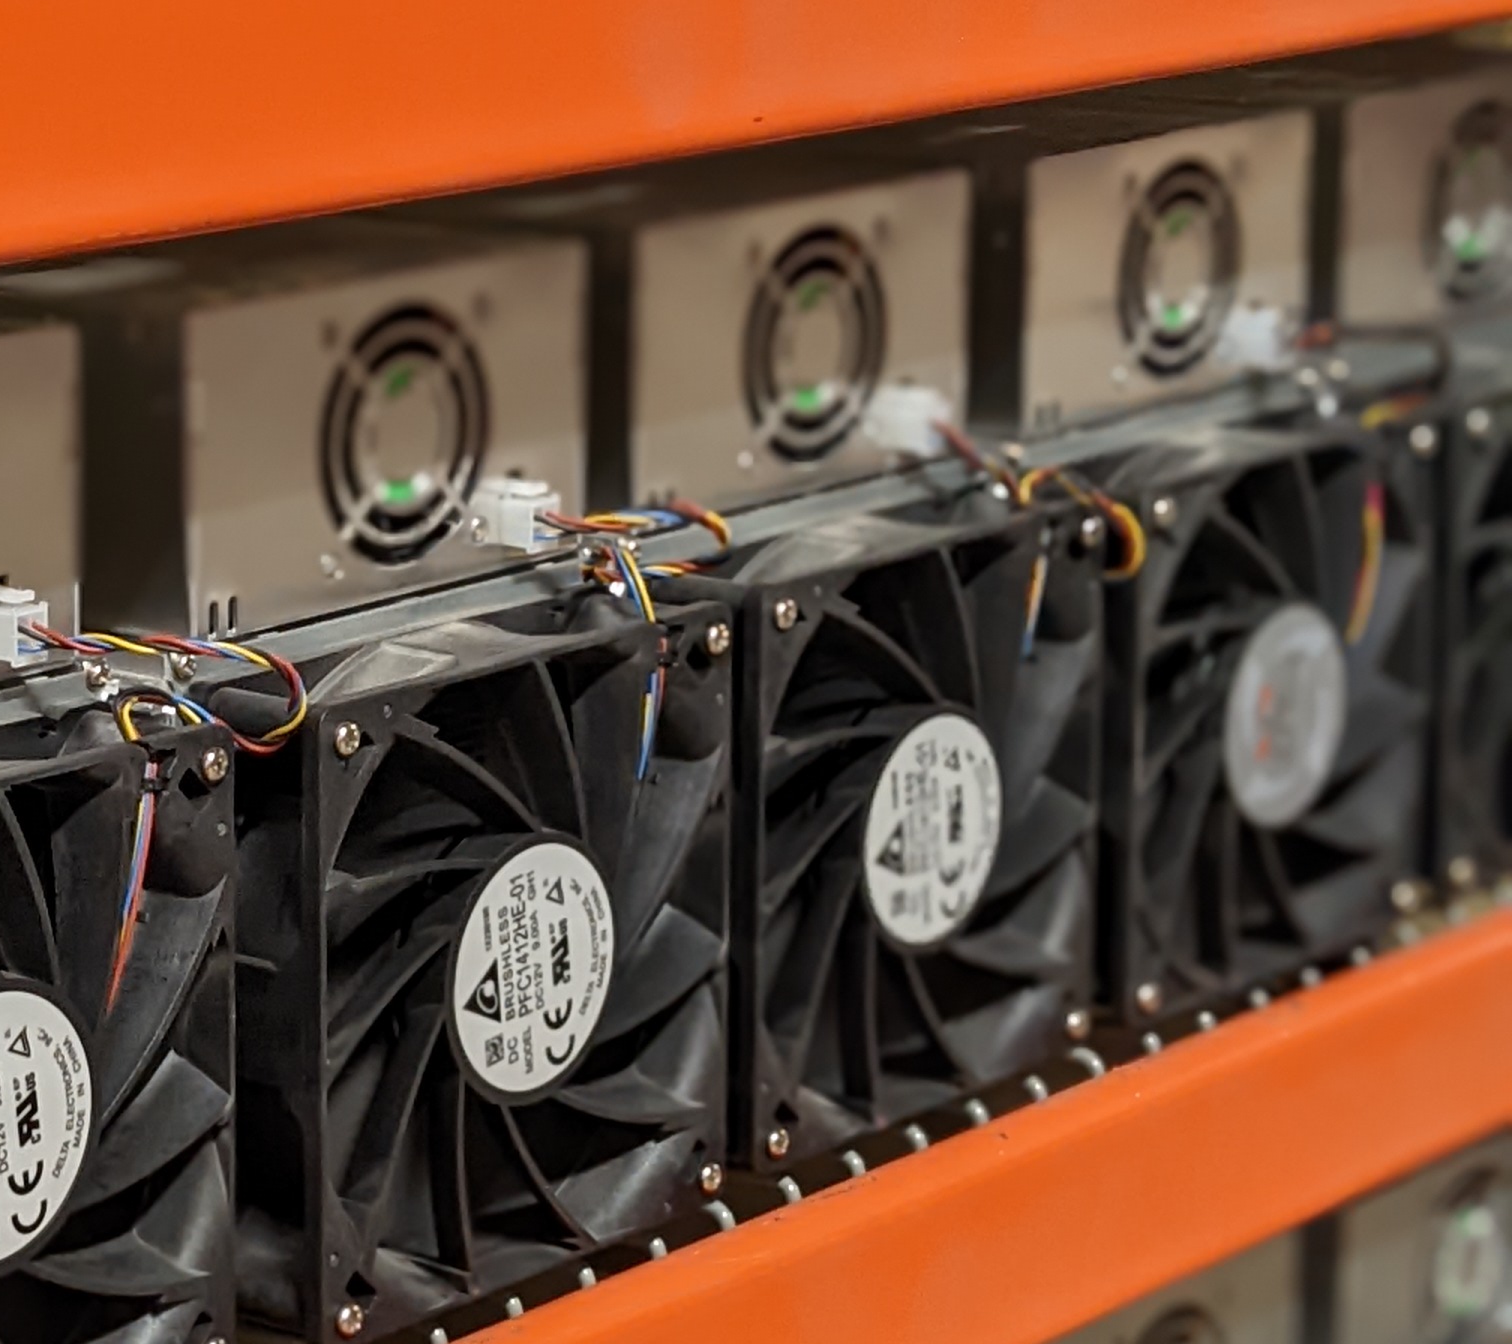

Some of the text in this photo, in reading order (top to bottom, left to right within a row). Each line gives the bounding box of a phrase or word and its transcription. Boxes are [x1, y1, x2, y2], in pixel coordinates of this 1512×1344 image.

[62, 1036, 85, 1148] MADE IN CHINA
[51, 1139, 71, 1179] DELTA
